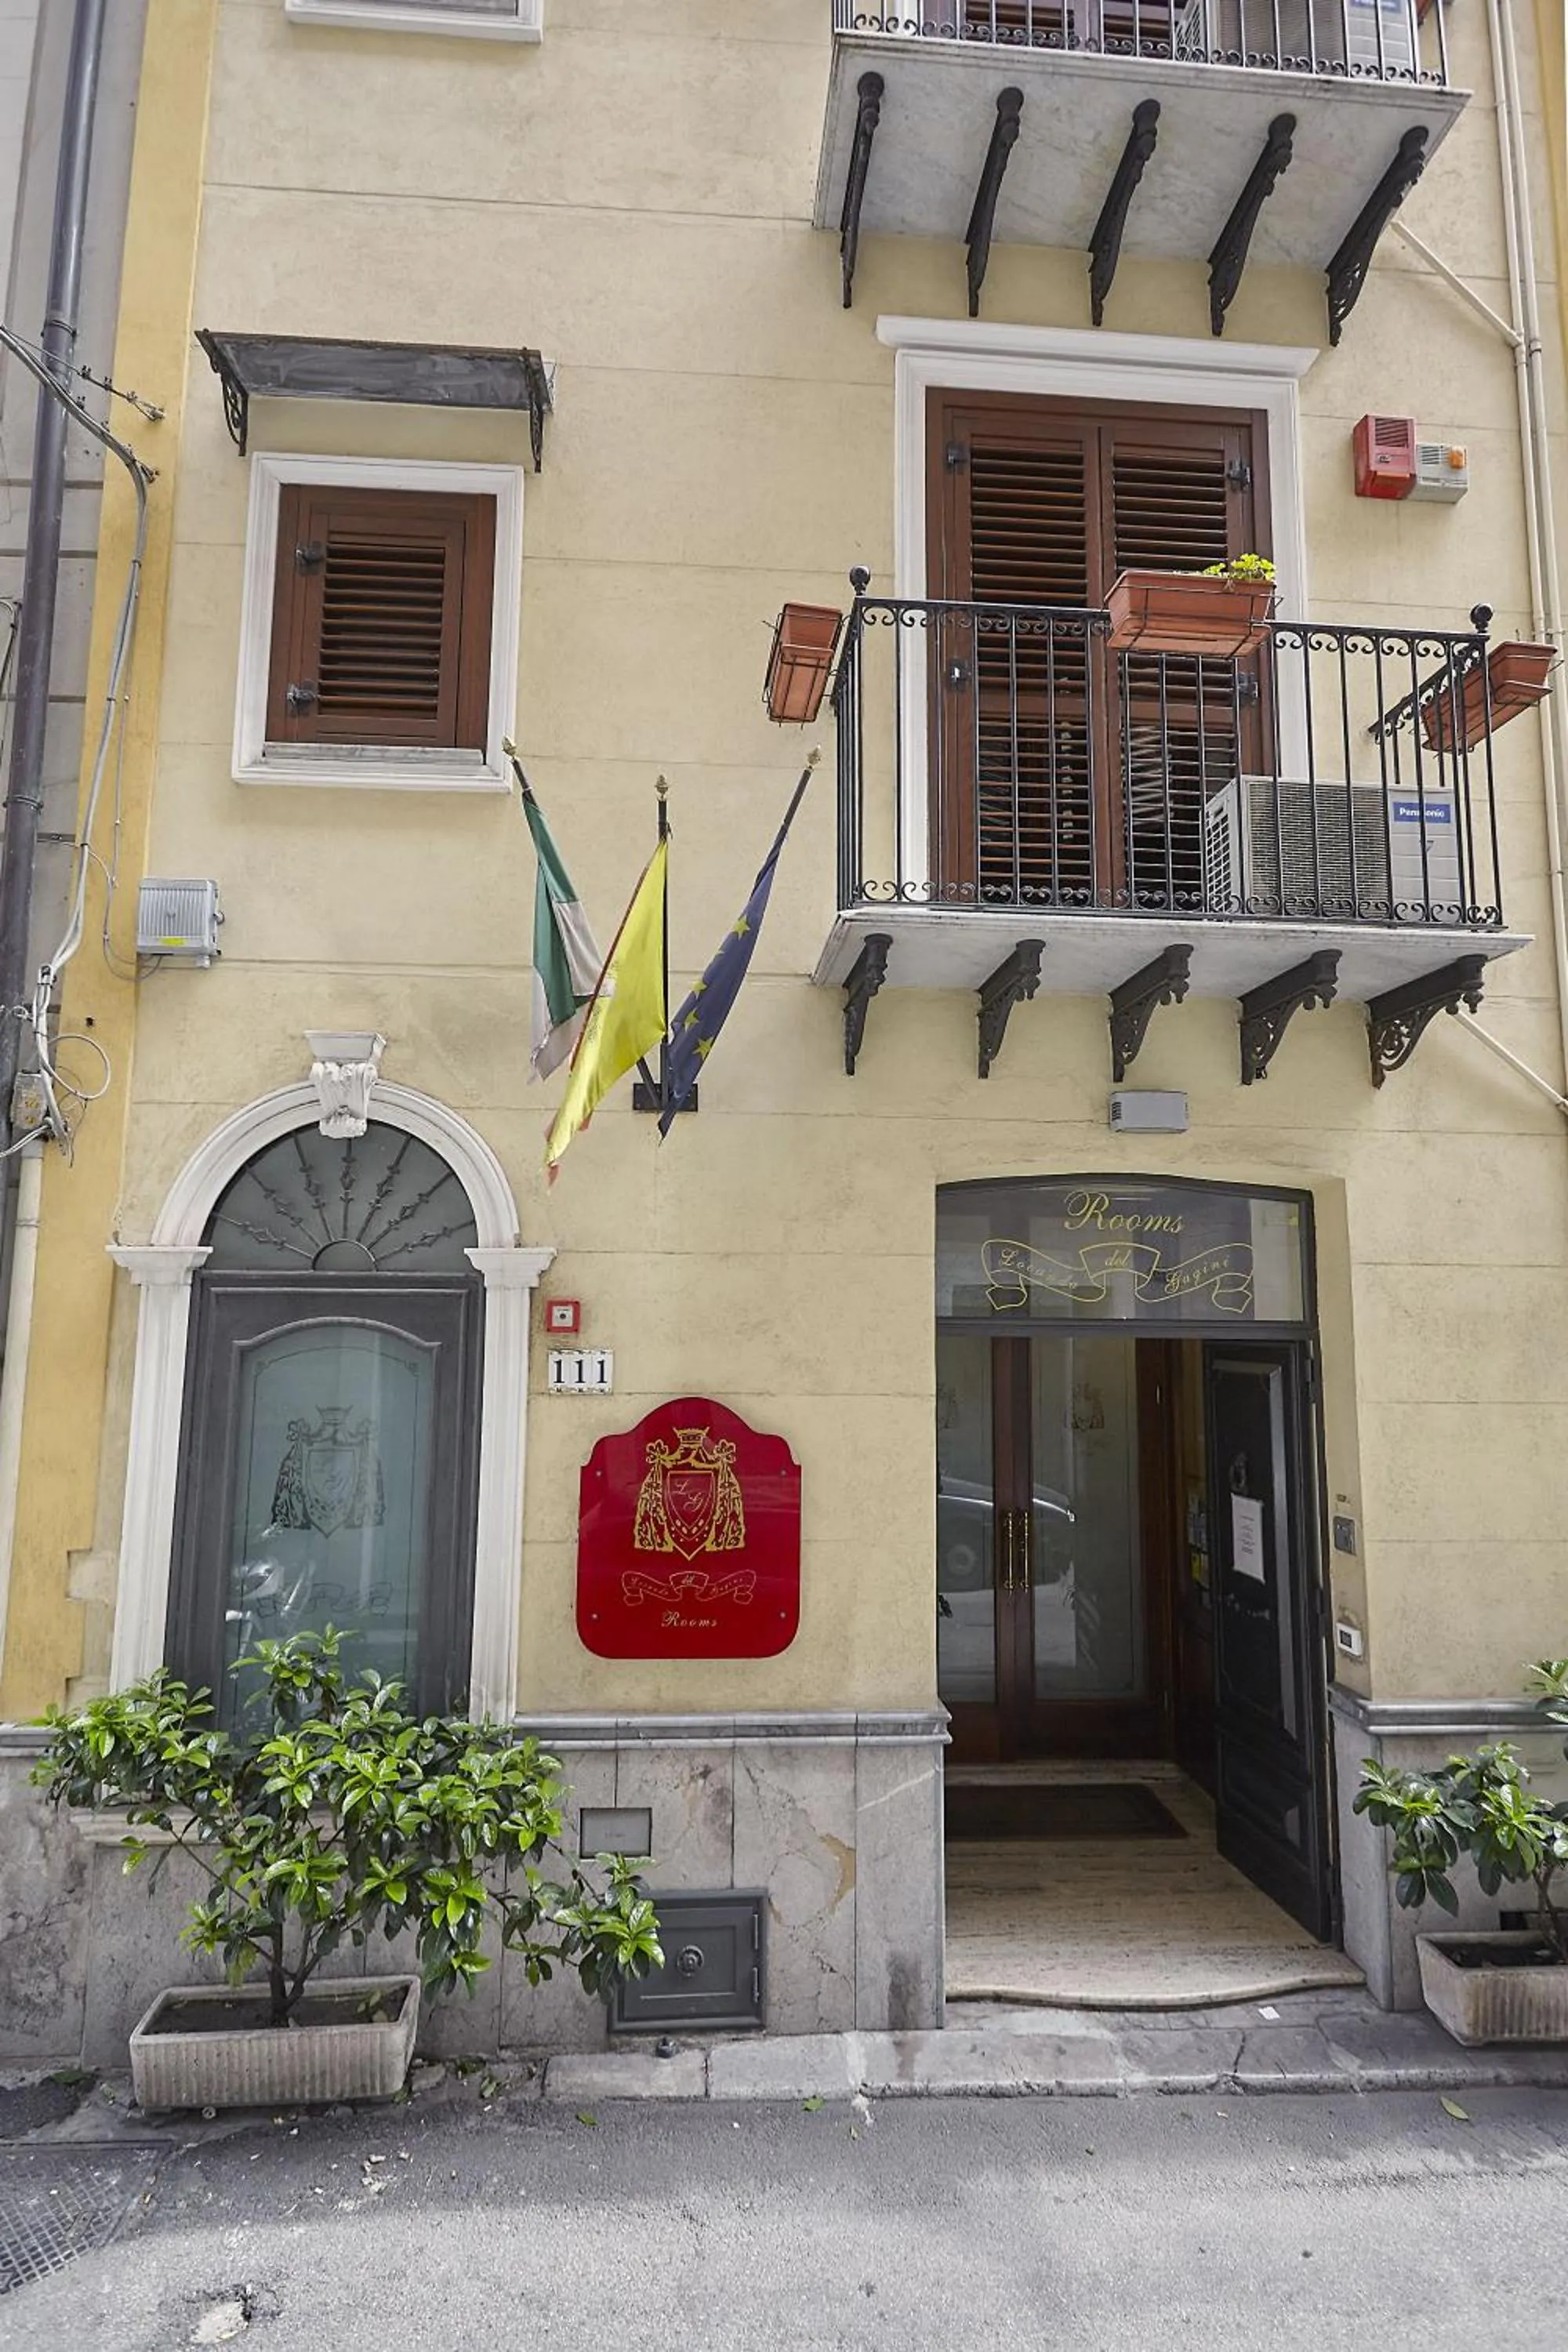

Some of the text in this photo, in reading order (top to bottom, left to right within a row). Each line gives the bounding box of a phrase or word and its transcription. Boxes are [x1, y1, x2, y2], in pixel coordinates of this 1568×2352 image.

[1399, 807, 1446, 818] Panonic
[1064, 1190, 1185, 1234] Rooms
[999, 1248, 1078, 1290] Locanda
[1104, 1249, 1132, 1268] del
[553, 1359, 608, 1384] 111
[661, 1610, 717, 1628] Rooms
